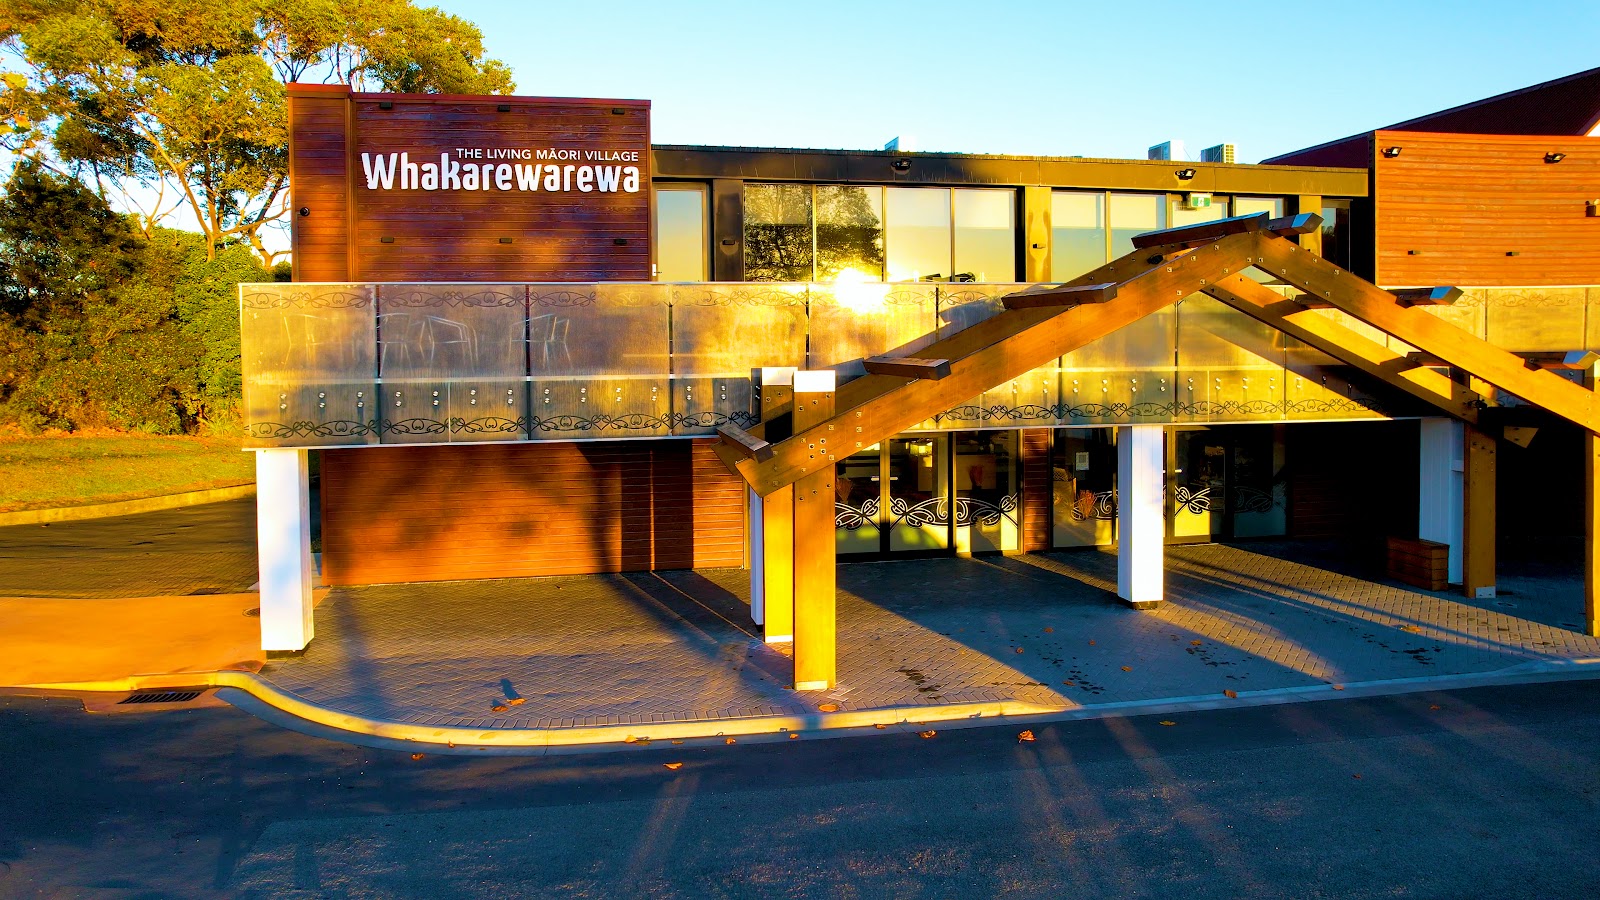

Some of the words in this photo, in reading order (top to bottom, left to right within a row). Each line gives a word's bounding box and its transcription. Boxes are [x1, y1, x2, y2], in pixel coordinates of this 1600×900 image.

[456, 148, 483, 159] THE
[486, 148, 532, 160] LIVING
[536, 148, 581, 161] MĀORI
[584, 150, 639, 162] VILLAGE
[361, 152, 640, 193] Whakarewarewa
